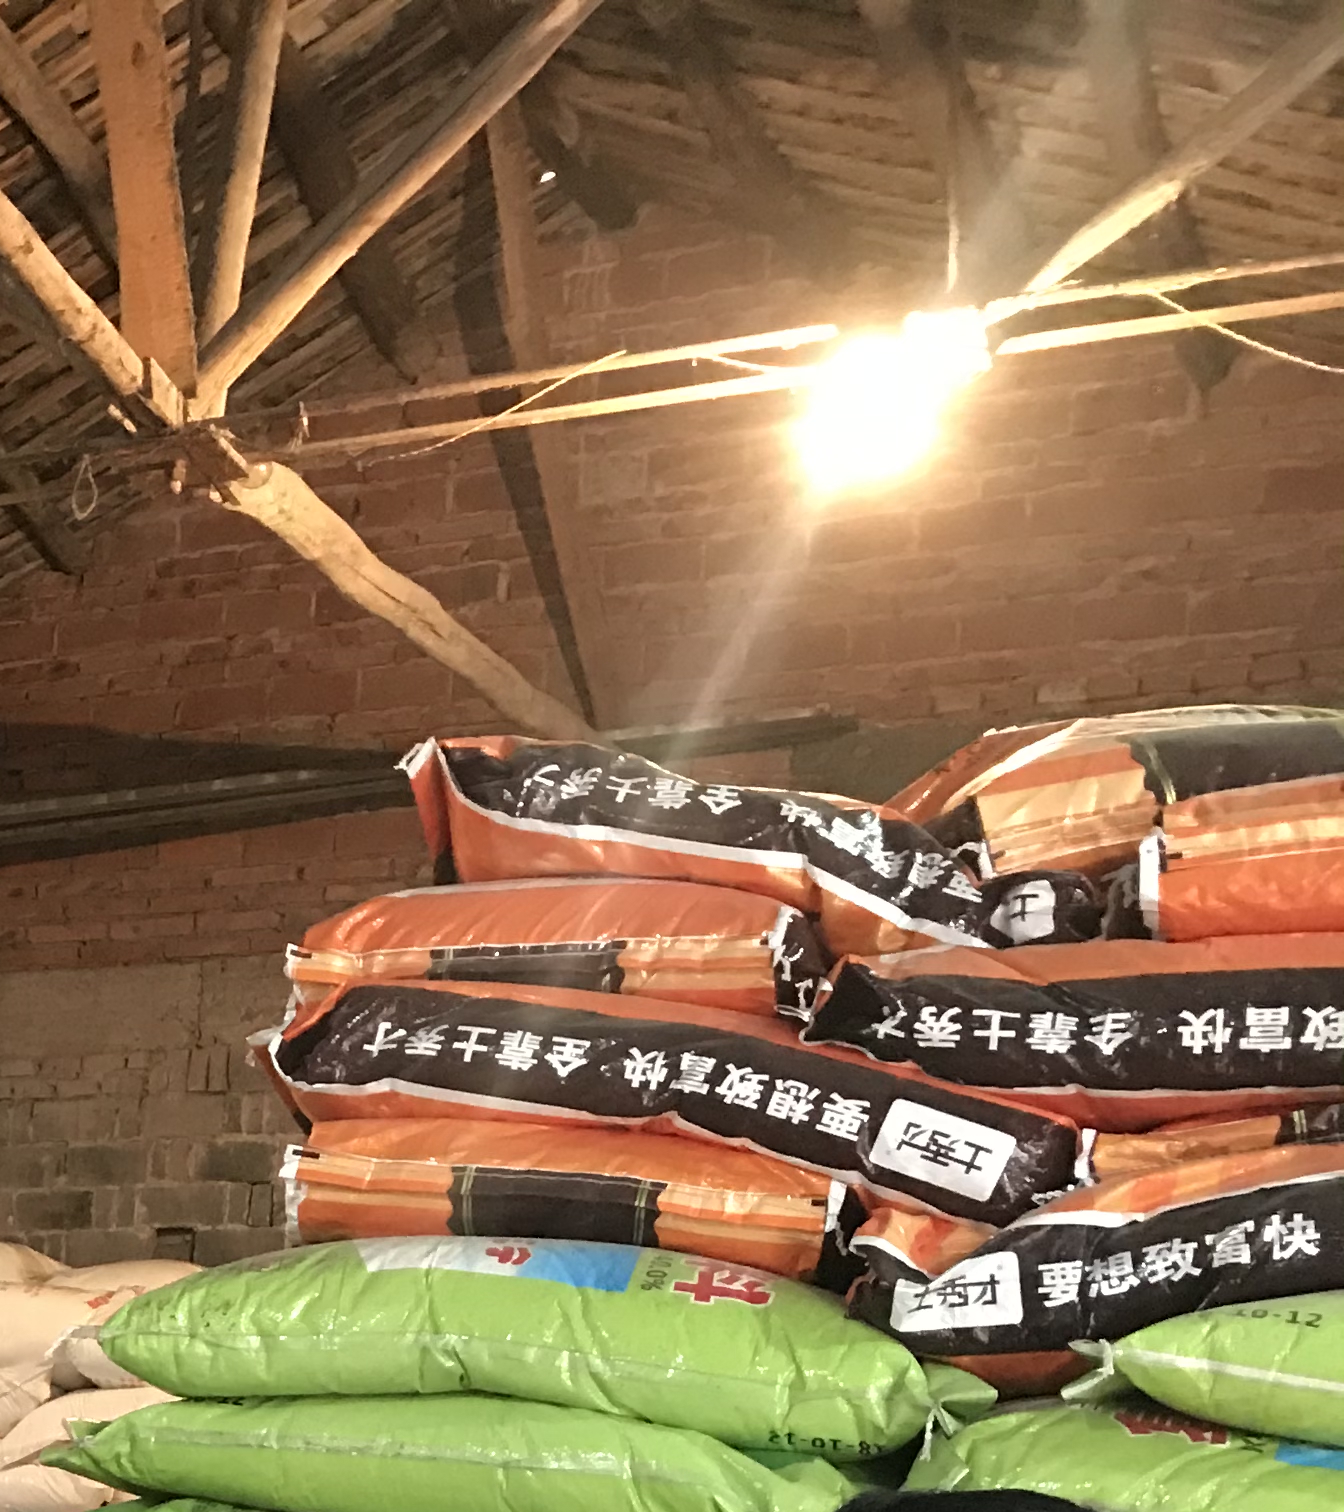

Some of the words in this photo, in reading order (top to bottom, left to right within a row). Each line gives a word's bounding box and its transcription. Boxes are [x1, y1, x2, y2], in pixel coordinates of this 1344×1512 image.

[622, 1045, 873, 1143] 要想致富快
[1036, 1211, 1324, 1310] 要想致富快
